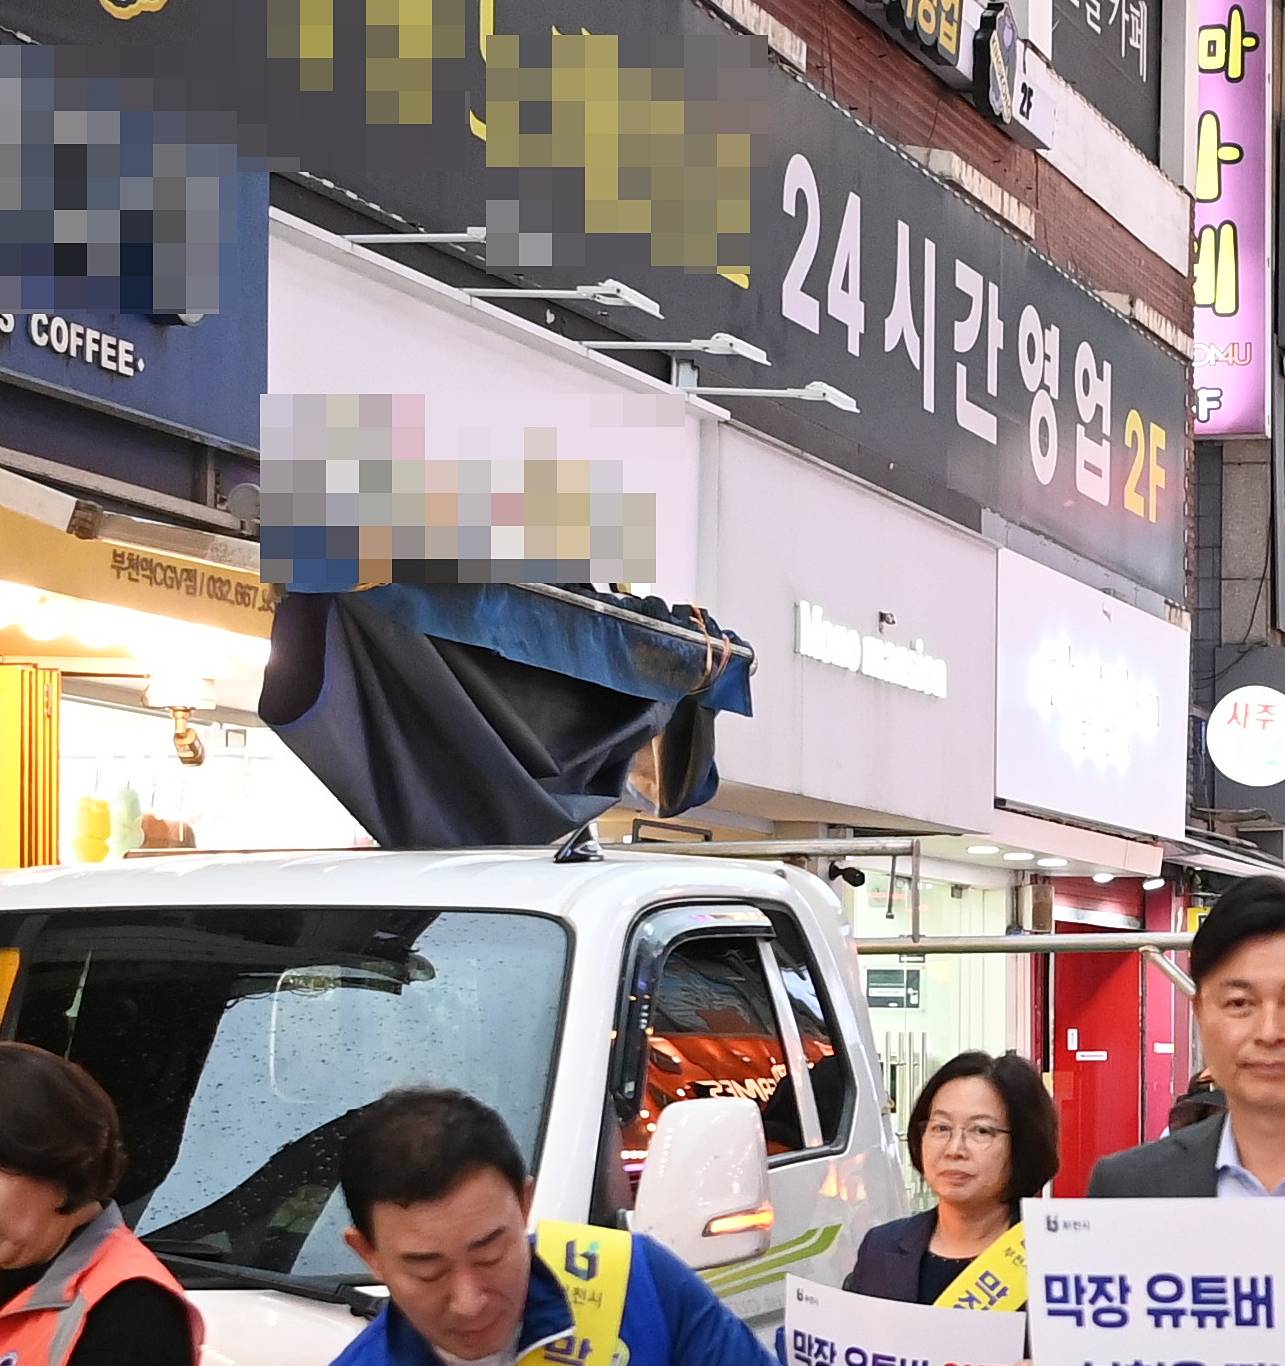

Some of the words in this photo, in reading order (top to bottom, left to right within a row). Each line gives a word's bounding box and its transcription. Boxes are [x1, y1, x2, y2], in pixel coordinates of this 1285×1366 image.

[1019, 81, 1034, 120] 2F
[31, 313, 135, 377] COFFEE
[1123, 408, 1168, 524] 2F
[1044, 1274, 1132, 1329] 막장
[1146, 1274, 1275, 1330] 유튜버
